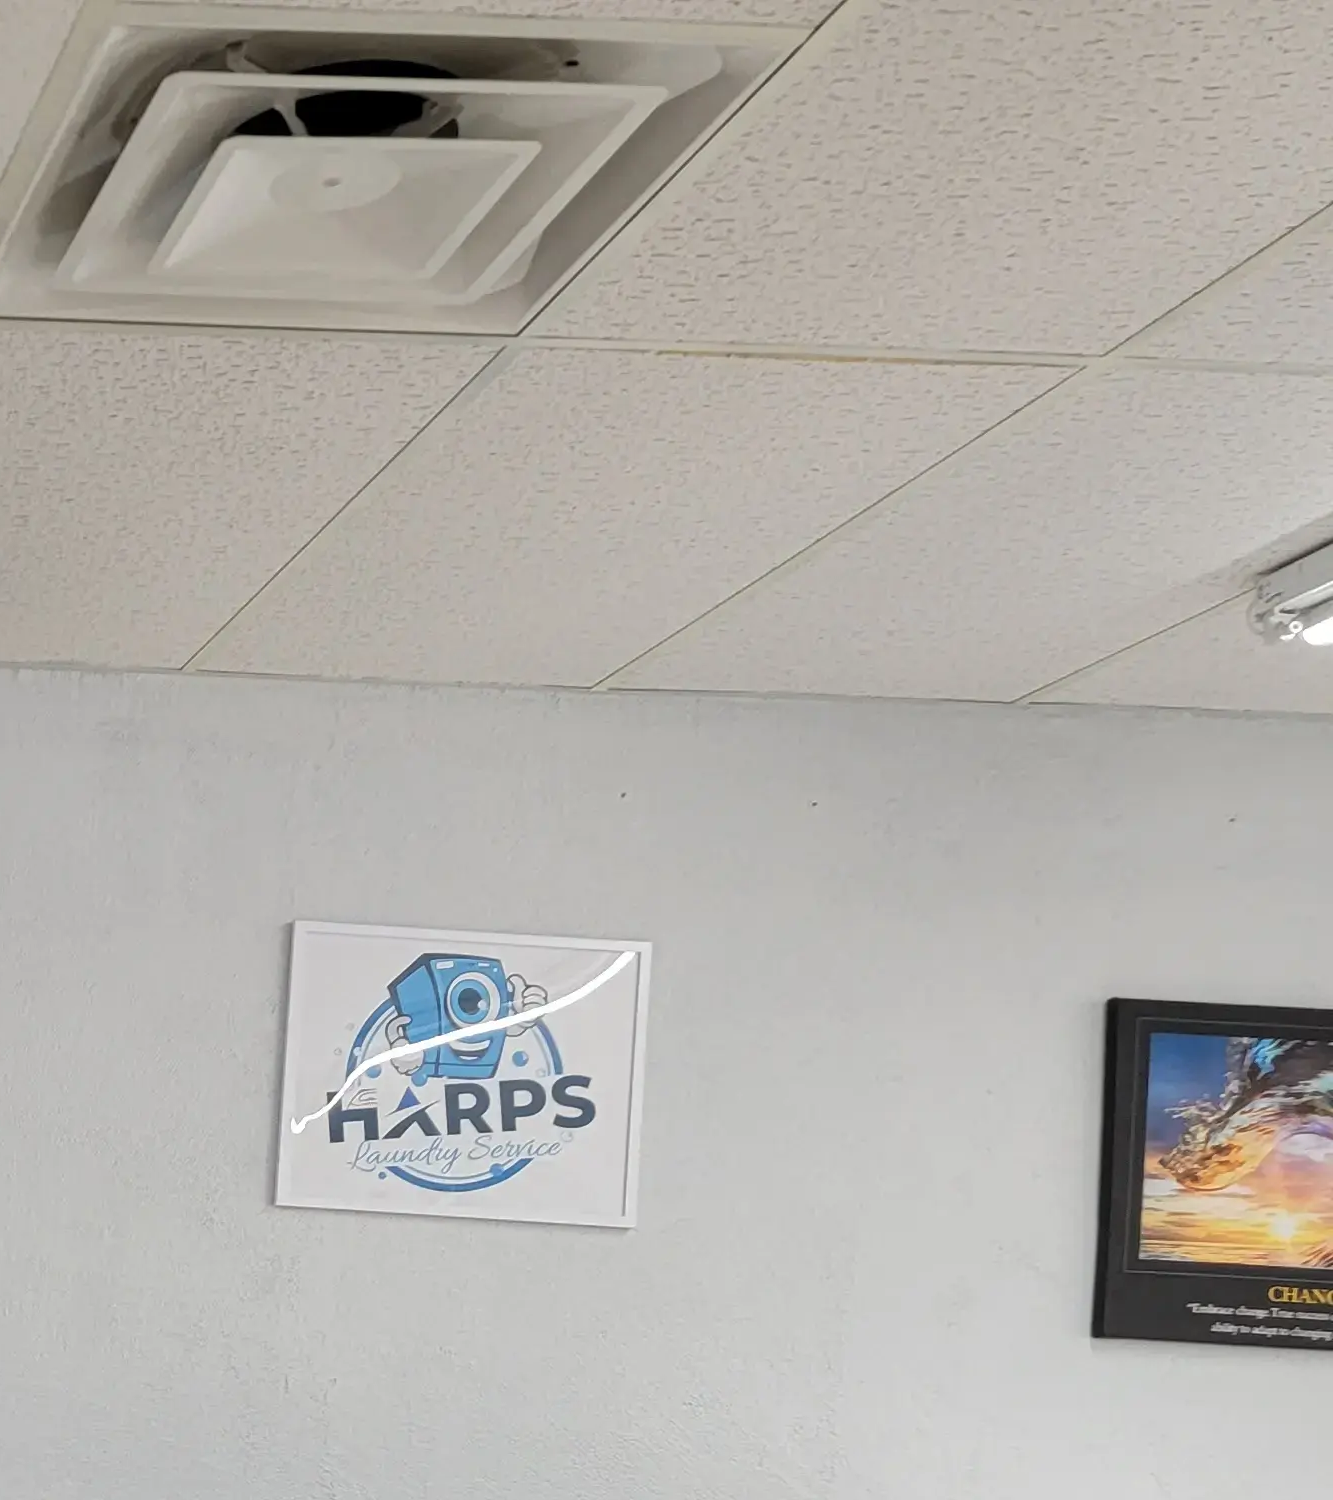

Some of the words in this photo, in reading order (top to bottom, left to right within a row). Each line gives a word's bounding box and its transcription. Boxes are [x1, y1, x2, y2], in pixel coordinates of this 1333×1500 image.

[326, 1074, 596, 1144] HARPS
[346, 1135, 462, 1175] Laundry
[468, 1134, 562, 1161] Service
